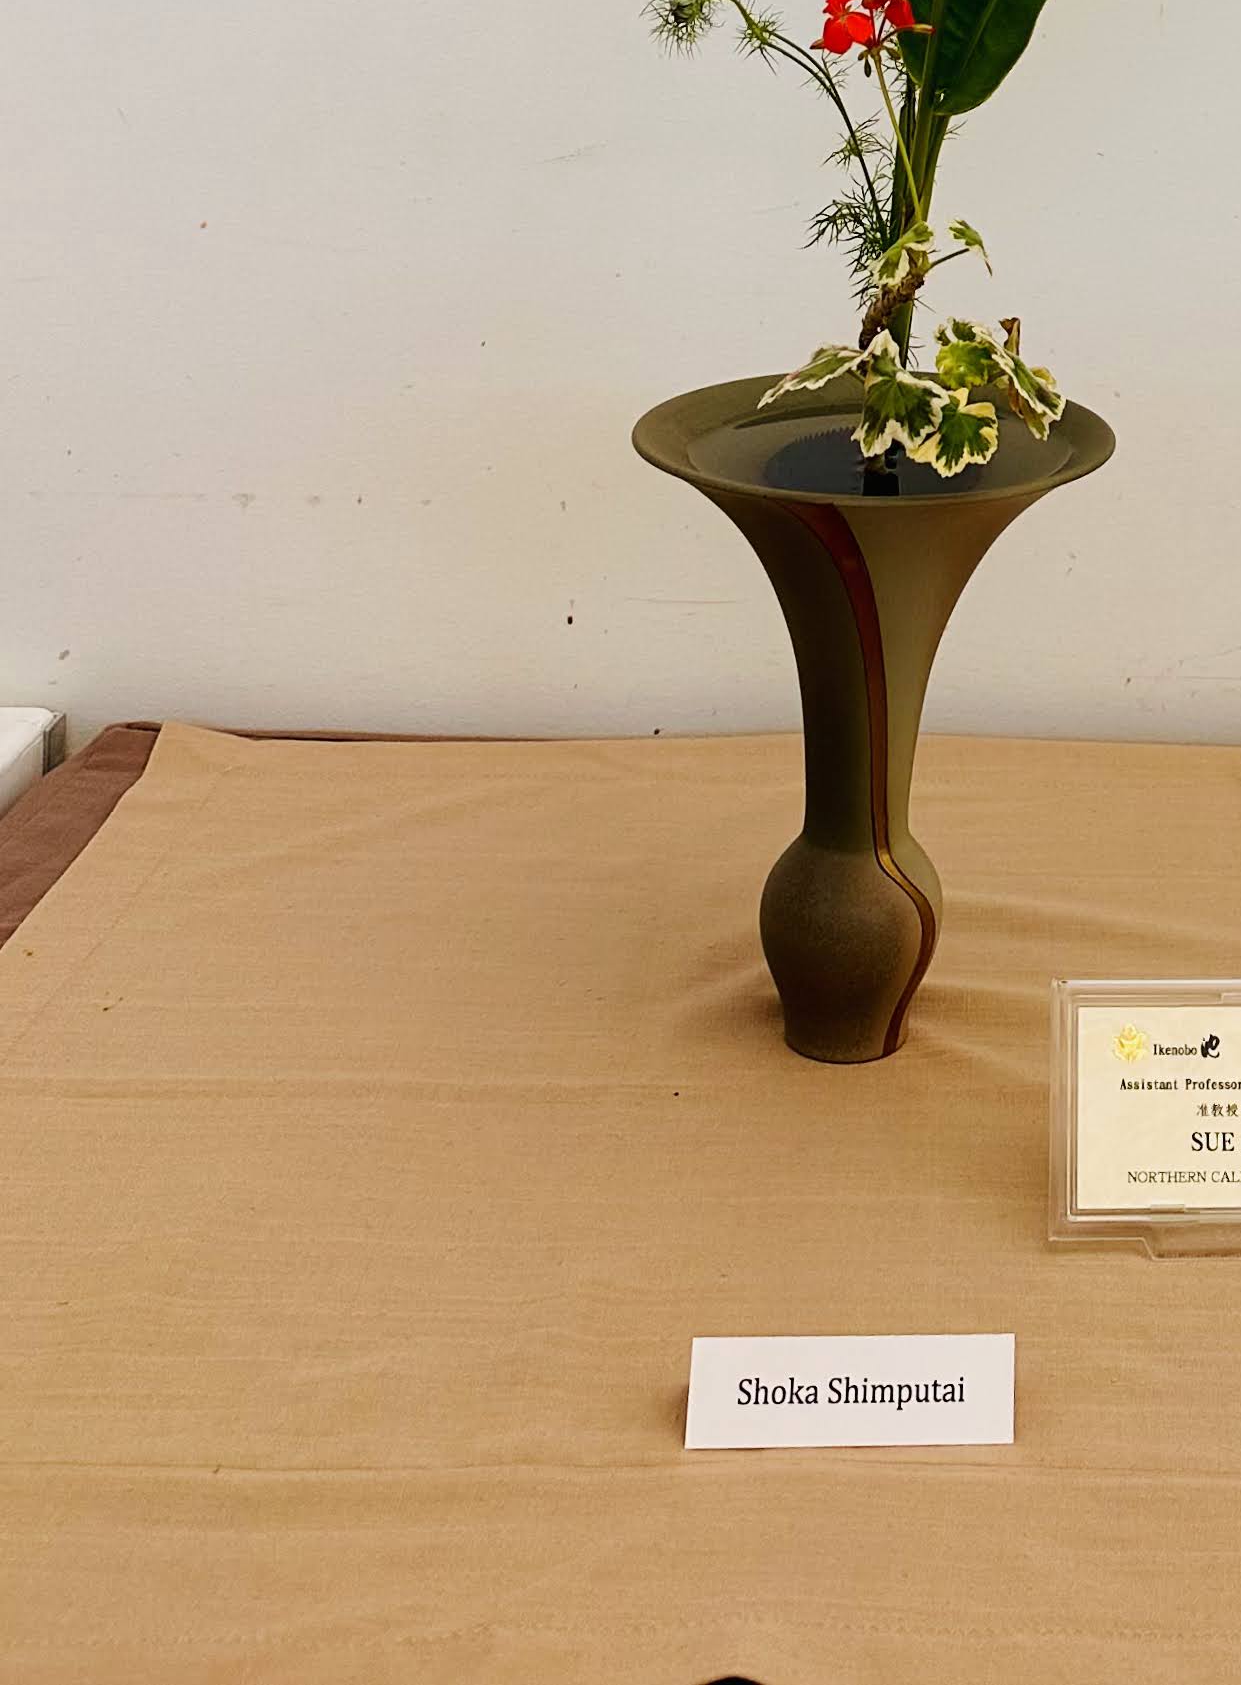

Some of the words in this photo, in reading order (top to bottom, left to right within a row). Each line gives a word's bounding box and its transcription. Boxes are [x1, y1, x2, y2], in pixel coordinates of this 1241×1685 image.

[1154, 1044, 1197, 1055] Ikenobo
[1120, 1079, 1178, 1090] Assistant
[1192, 1132, 1234, 1151] SUE
[1128, 1172, 1206, 1183] NORTHERN
[738, 1377, 818, 1405] Shoka
[828, 1377, 964, 1410] Shimputai
